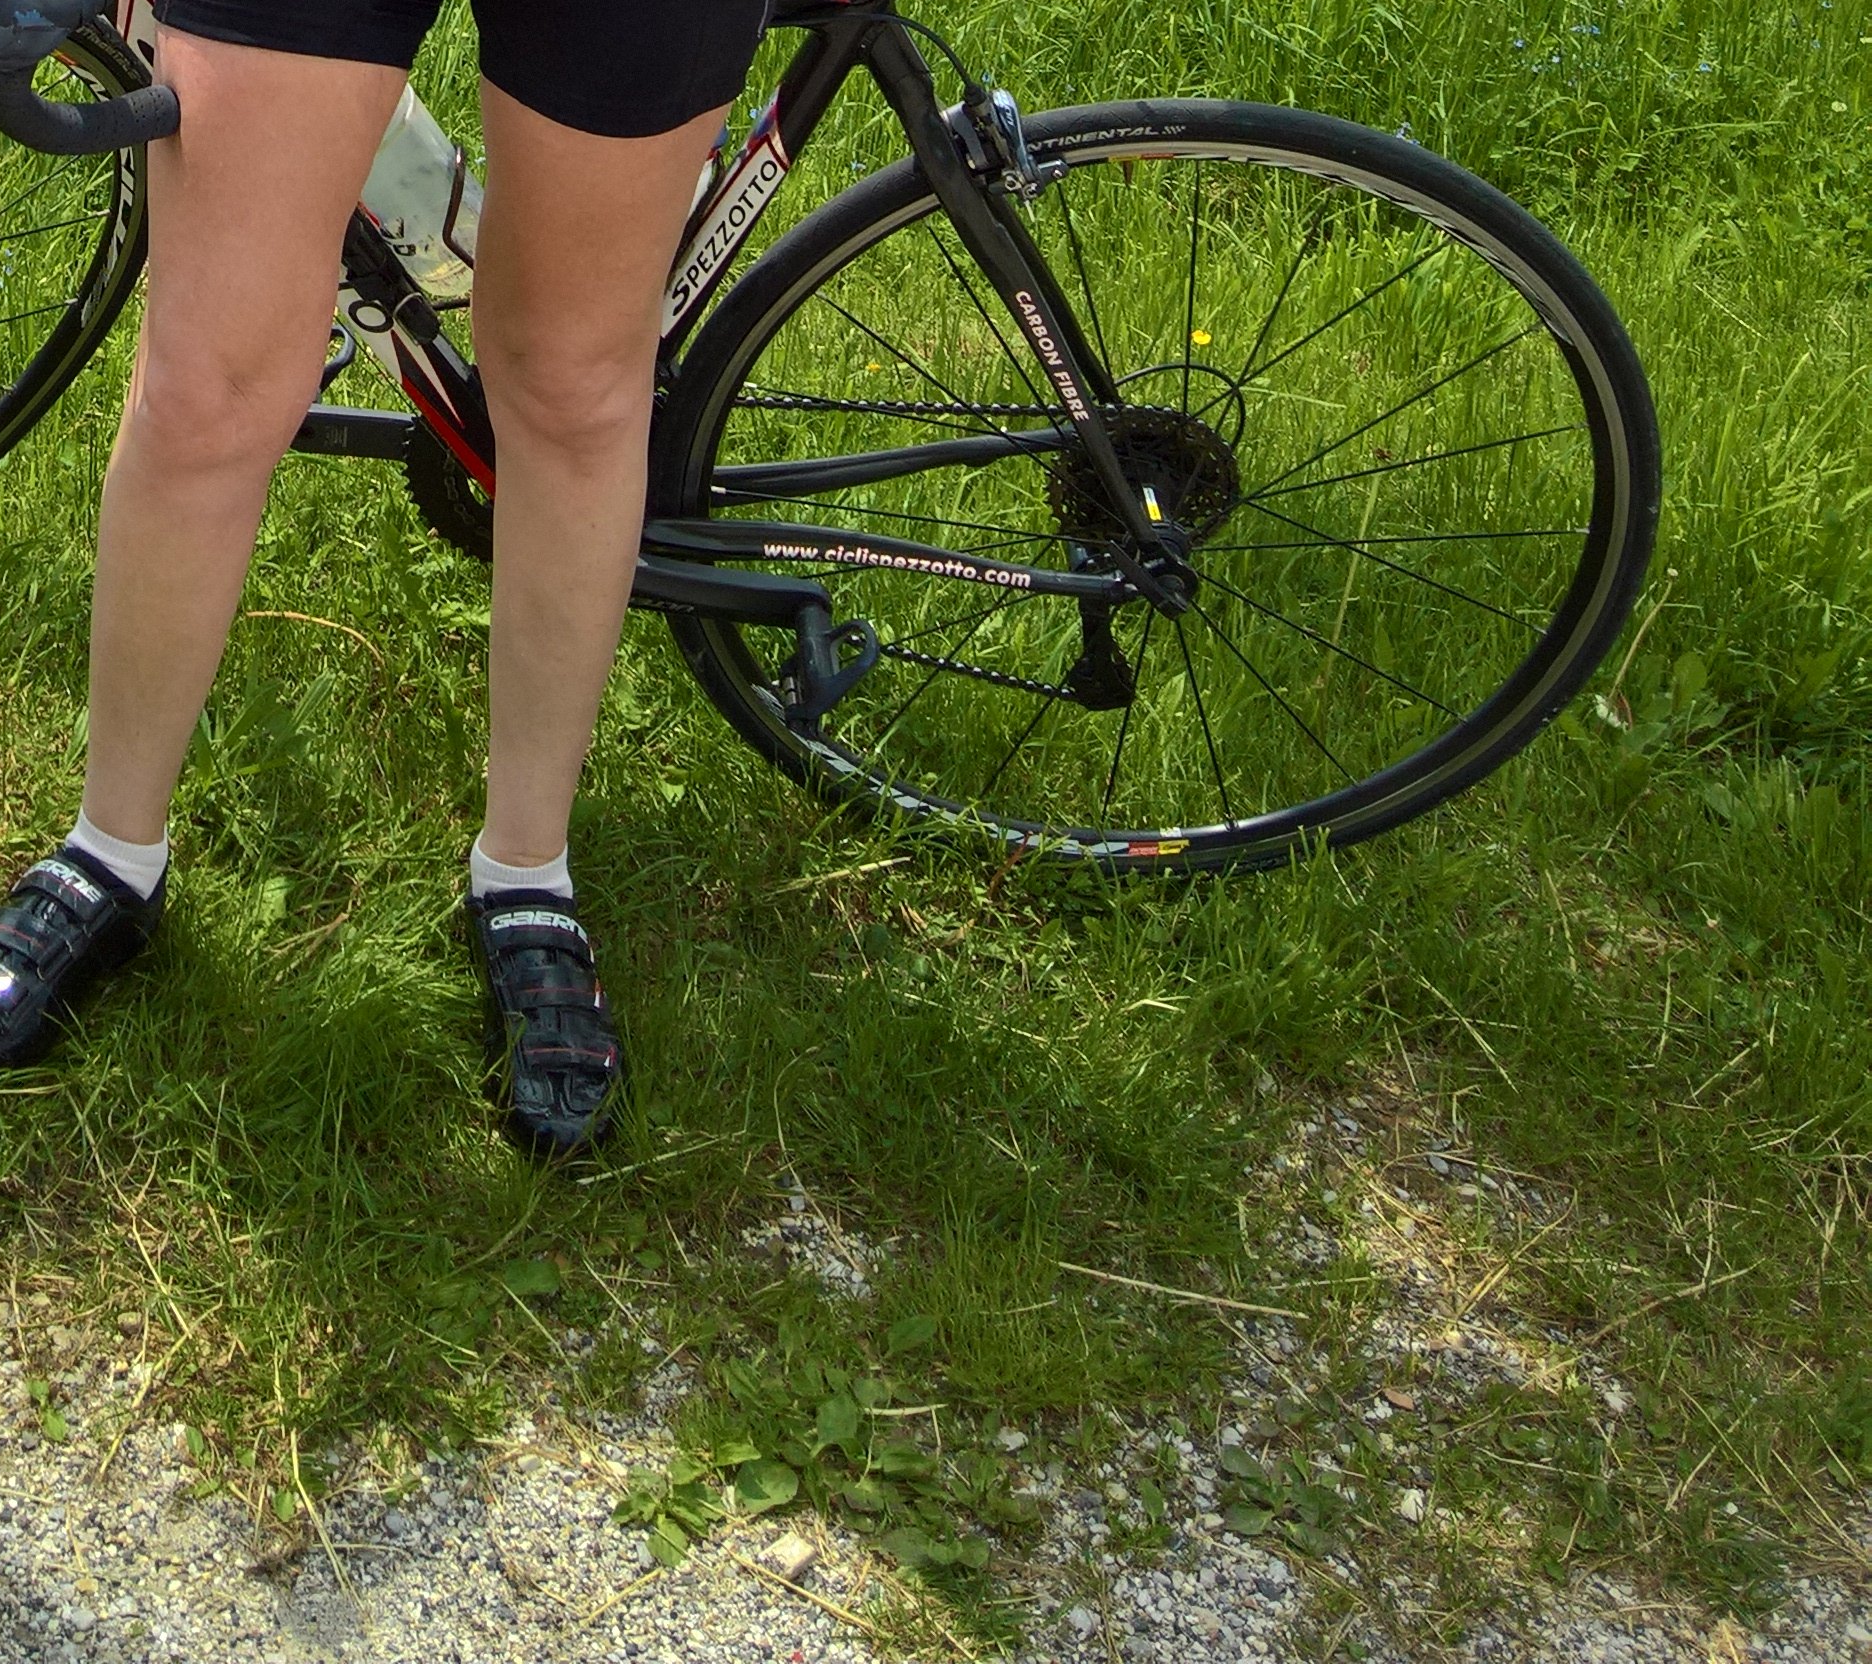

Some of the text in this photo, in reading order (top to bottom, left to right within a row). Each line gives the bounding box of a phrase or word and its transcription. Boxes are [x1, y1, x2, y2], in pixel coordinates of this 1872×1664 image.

[1027, 126, 1159, 153] NTINENTAL
[672, 160, 778, 316] SPEZZOTTO
[1016, 291, 1089, 421] CARBON FIBRE
[763, 543, 1032, 588] www.ciclispezzotto.com
[490, 910, 588, 945] GAERN
